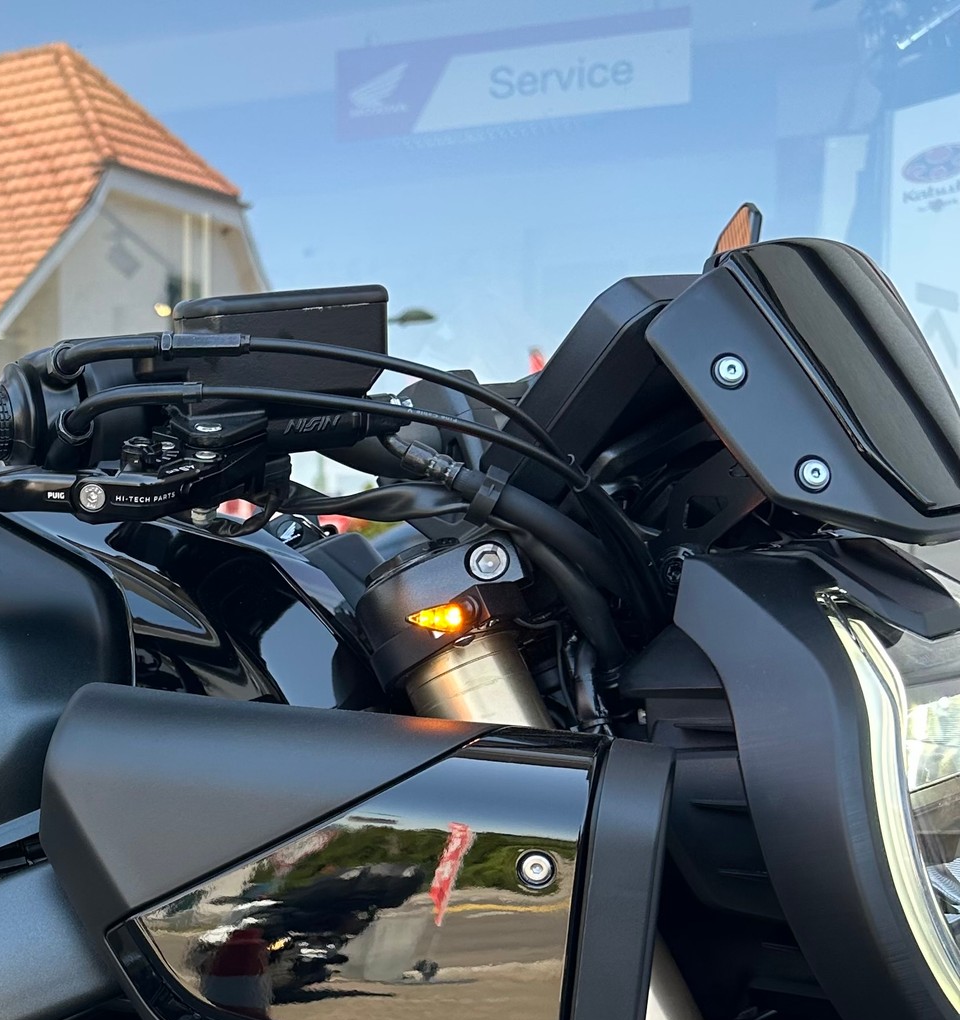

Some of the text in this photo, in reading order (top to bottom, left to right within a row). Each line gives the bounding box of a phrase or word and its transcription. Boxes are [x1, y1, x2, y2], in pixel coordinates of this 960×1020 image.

[489, 57, 634, 100] Service
[47, 491, 65, 499] PUIG
[115, 491, 176, 503] HI-TECH PARTS
